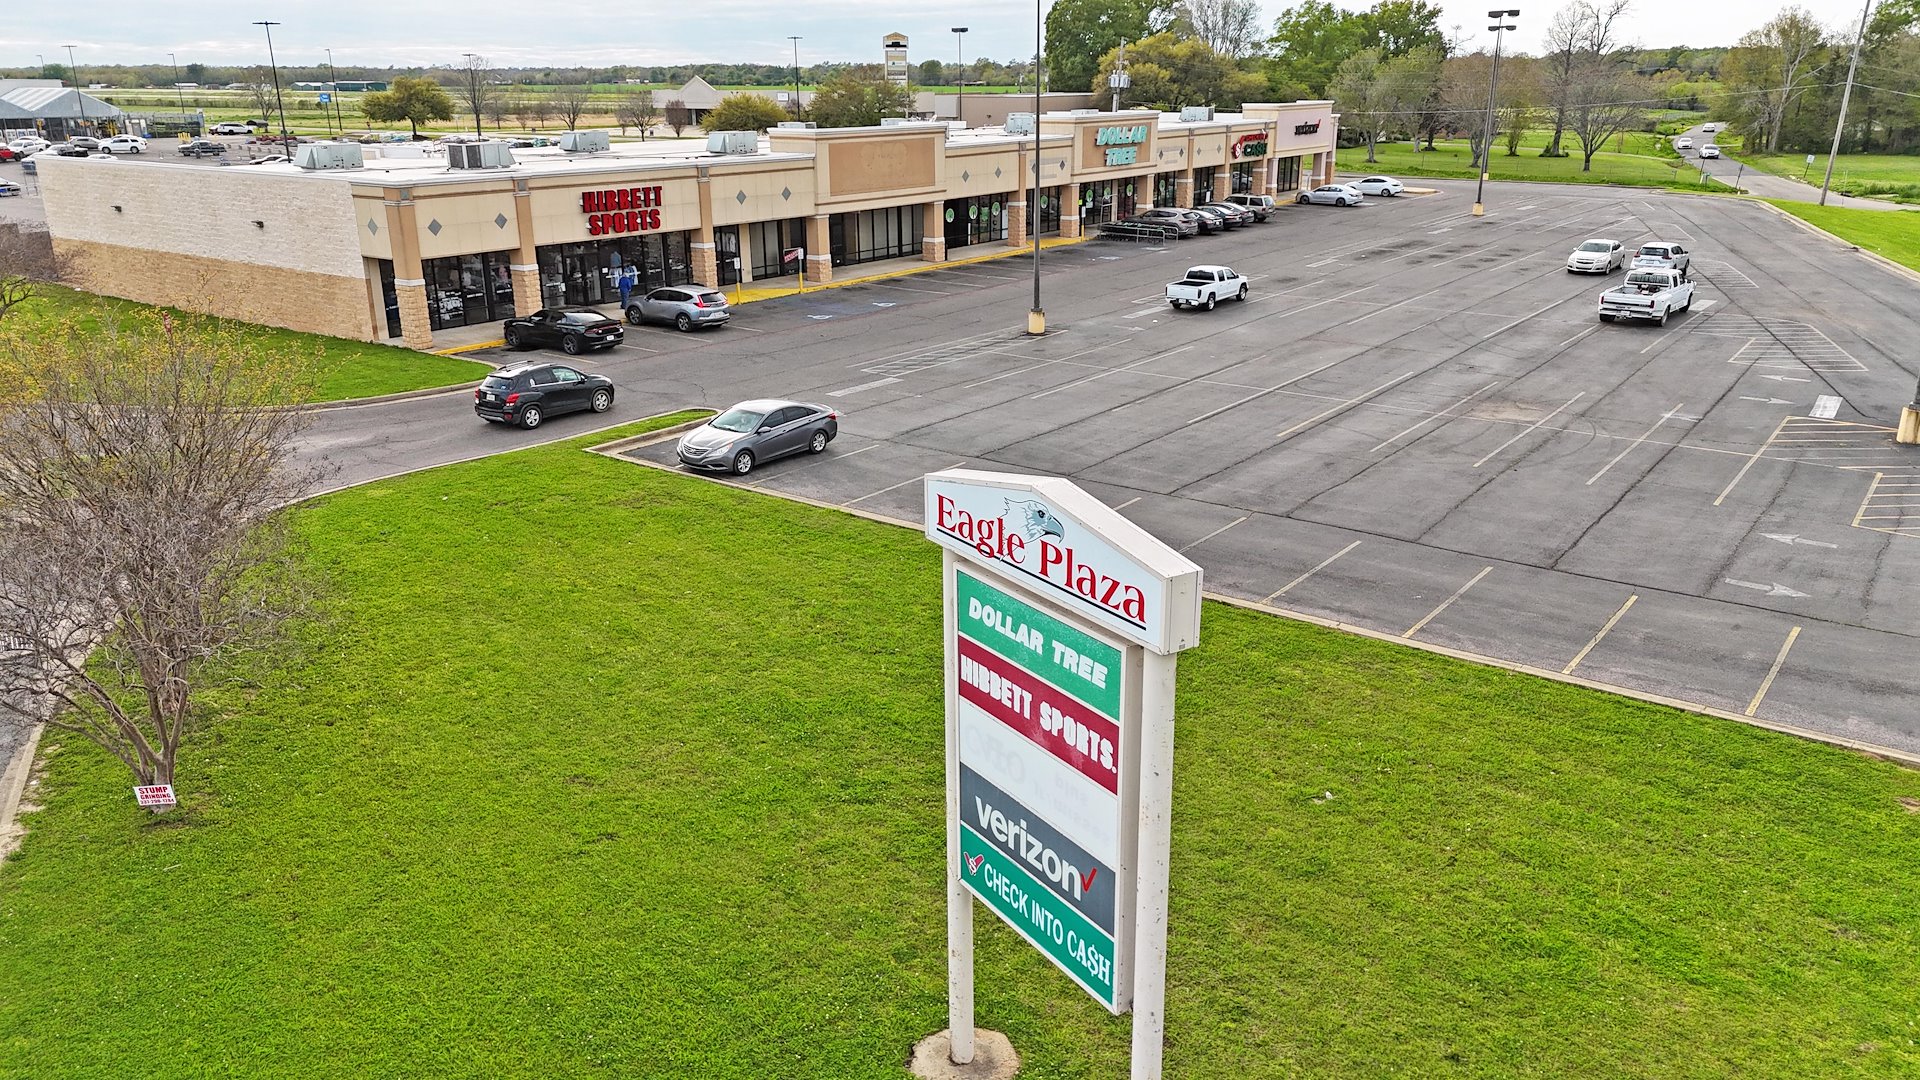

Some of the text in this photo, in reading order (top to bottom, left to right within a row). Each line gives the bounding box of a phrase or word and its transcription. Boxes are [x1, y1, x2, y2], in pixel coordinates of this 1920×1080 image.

[1096, 125, 1147, 146] DOLLAR
[1105, 146, 1137, 167] TREE
[582, 185, 662, 213] HIBBETT
[588, 209, 661, 236] SPORTS
[936, 493, 1147, 623] Eagle Plaza
[968, 596, 1108, 690] DOLLAR TREE
[960, 653, 1032, 720] HIBBETT
[138, 786, 168, 794] STUMP
[975, 795, 1082, 901] verizon
[984, 863, 1029, 919] CHECK
[1032, 902, 1064, 945] INTO
